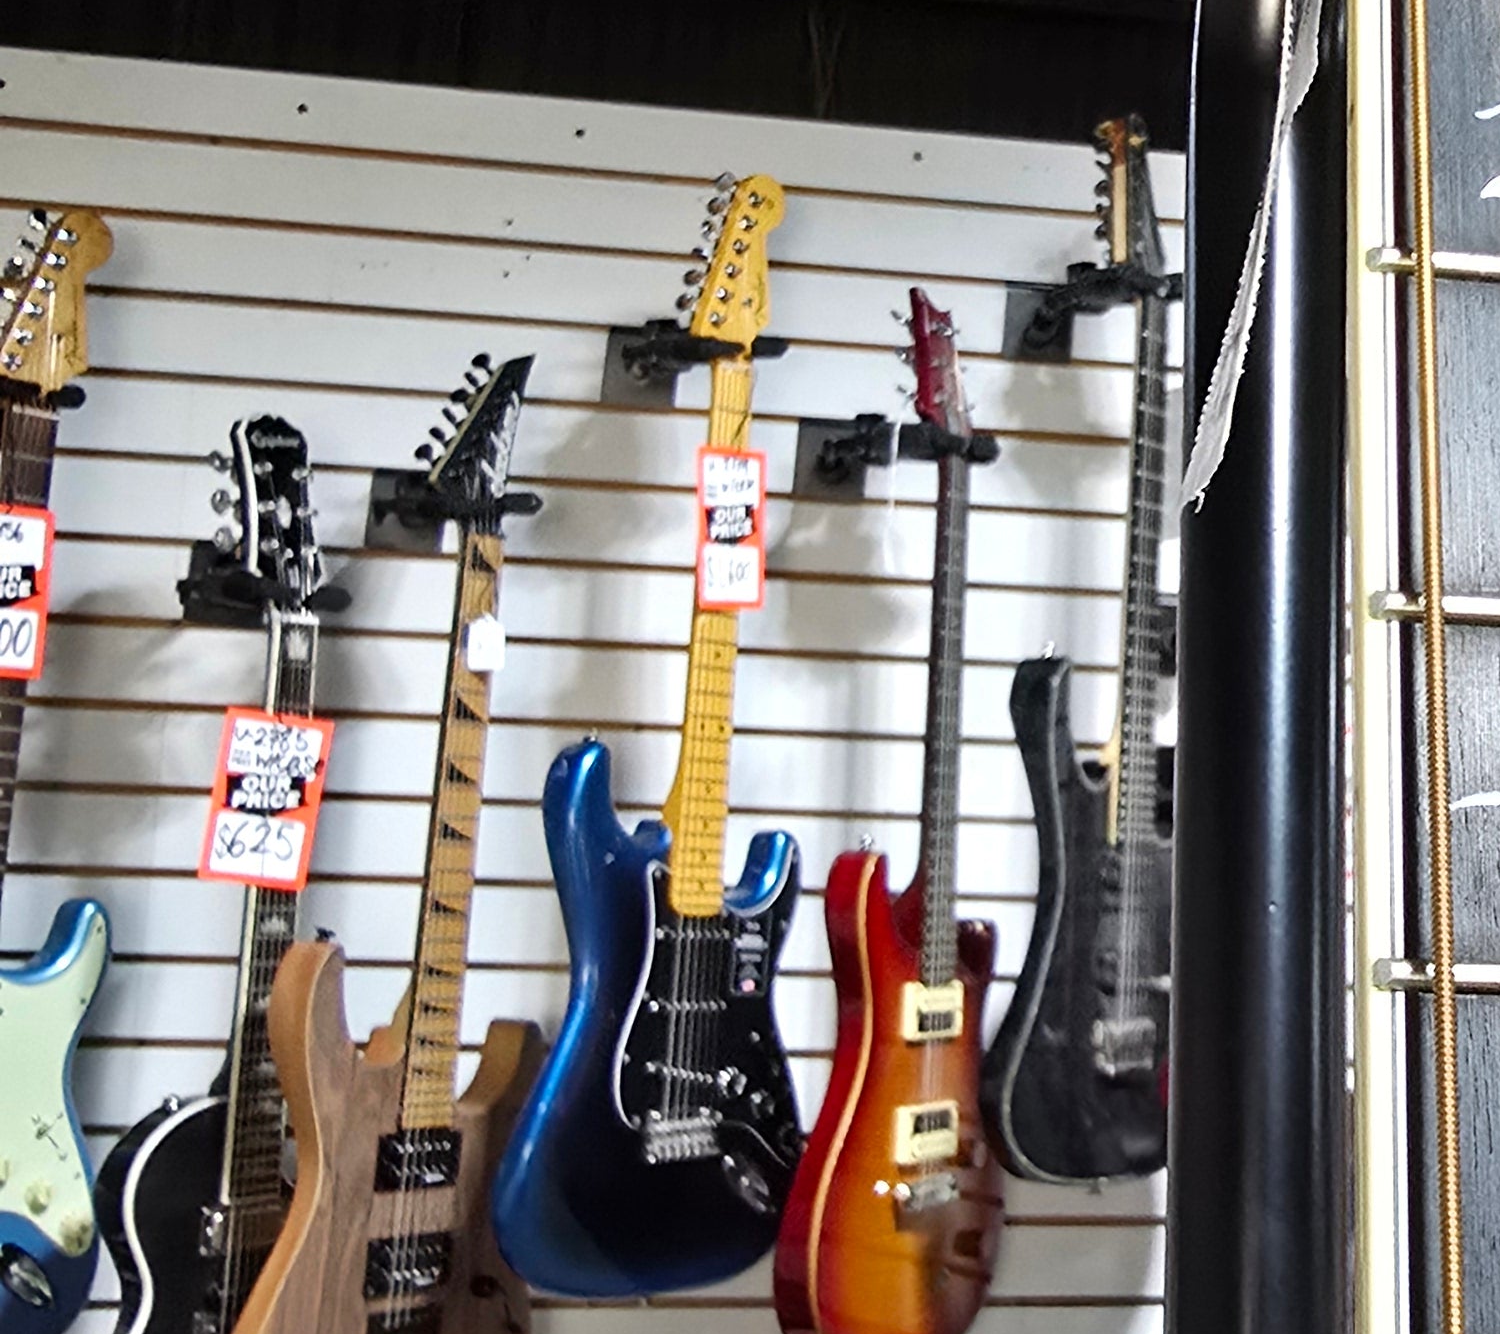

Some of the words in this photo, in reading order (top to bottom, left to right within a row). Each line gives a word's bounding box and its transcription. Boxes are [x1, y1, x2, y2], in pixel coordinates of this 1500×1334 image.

[0, 617, 33, 658] 00
[241, 773, 292, 792] OUR
[230, 788, 301, 809] PRICE
[214, 820, 295, 861] $625
